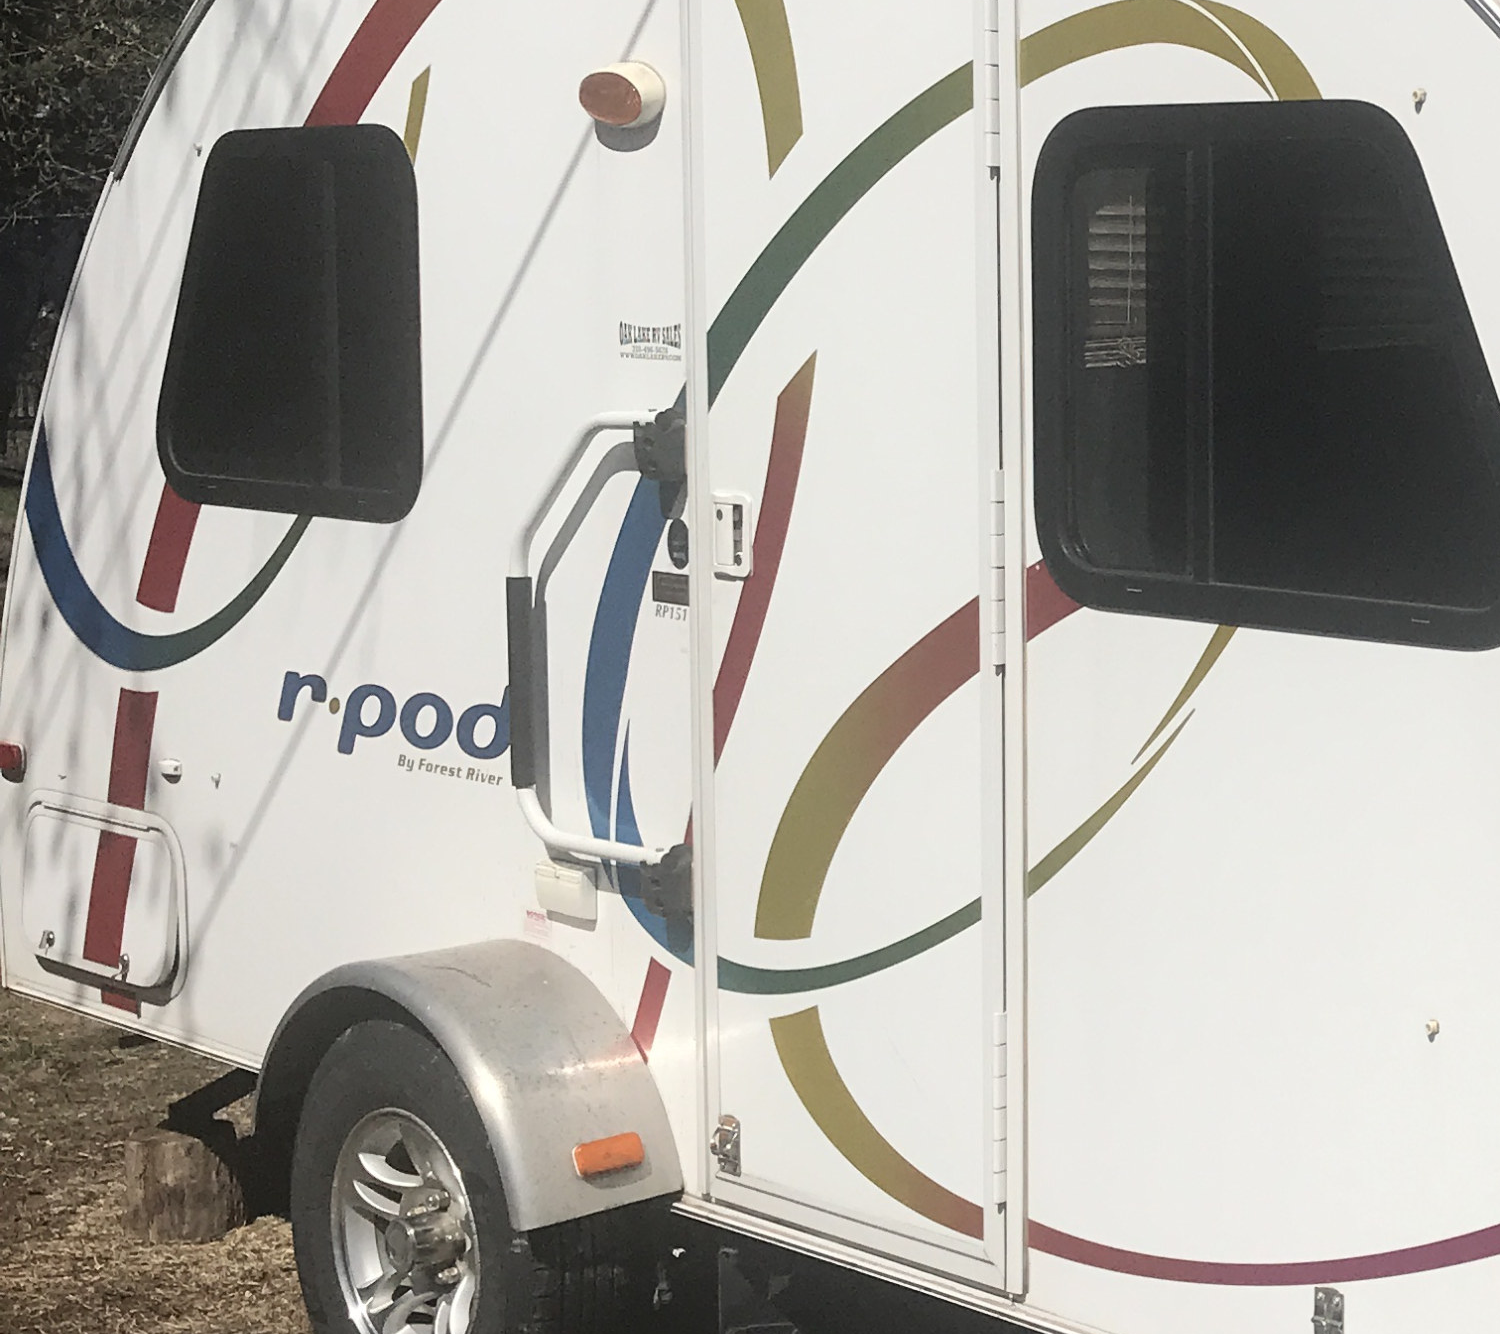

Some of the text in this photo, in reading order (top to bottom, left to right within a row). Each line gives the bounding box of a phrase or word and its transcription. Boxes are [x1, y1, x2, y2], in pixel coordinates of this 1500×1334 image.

[619, 321, 681, 349] OAK LAKE RV SALES
[655, 604, 687, 622] RP151
[397, 753, 504, 787] By Forest River
